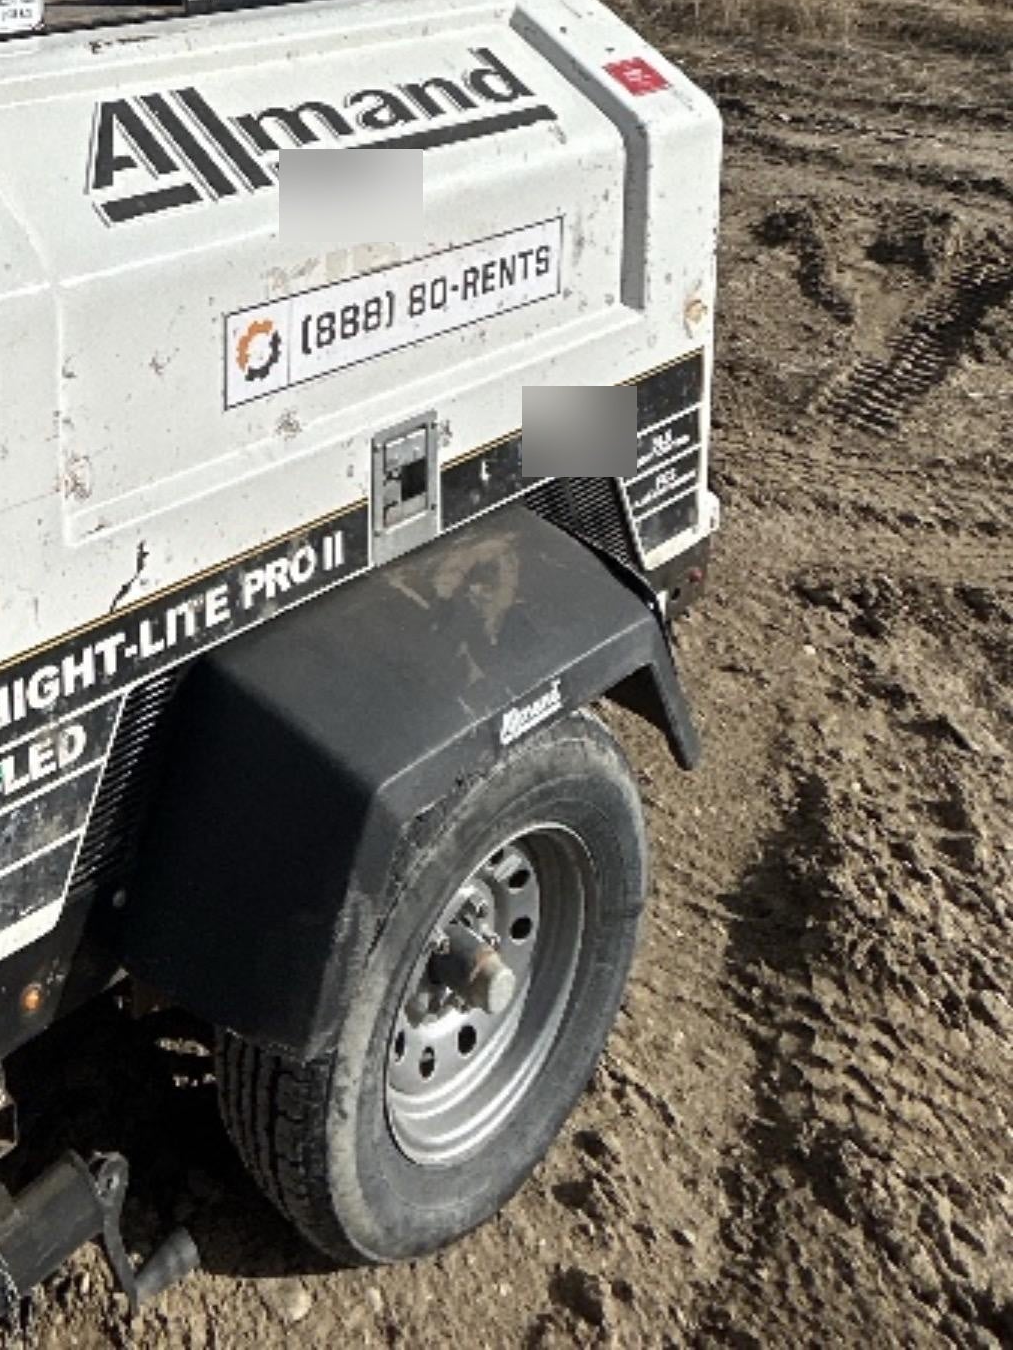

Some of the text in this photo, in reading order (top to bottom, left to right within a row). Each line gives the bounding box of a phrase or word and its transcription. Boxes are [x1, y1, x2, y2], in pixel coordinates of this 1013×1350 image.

[85, 47, 533, 205] Allmand
[301, 244, 551, 355] (888) 80-RENTS
[242, 544, 318, 609] PRO
[322, 530, 345, 571] II
